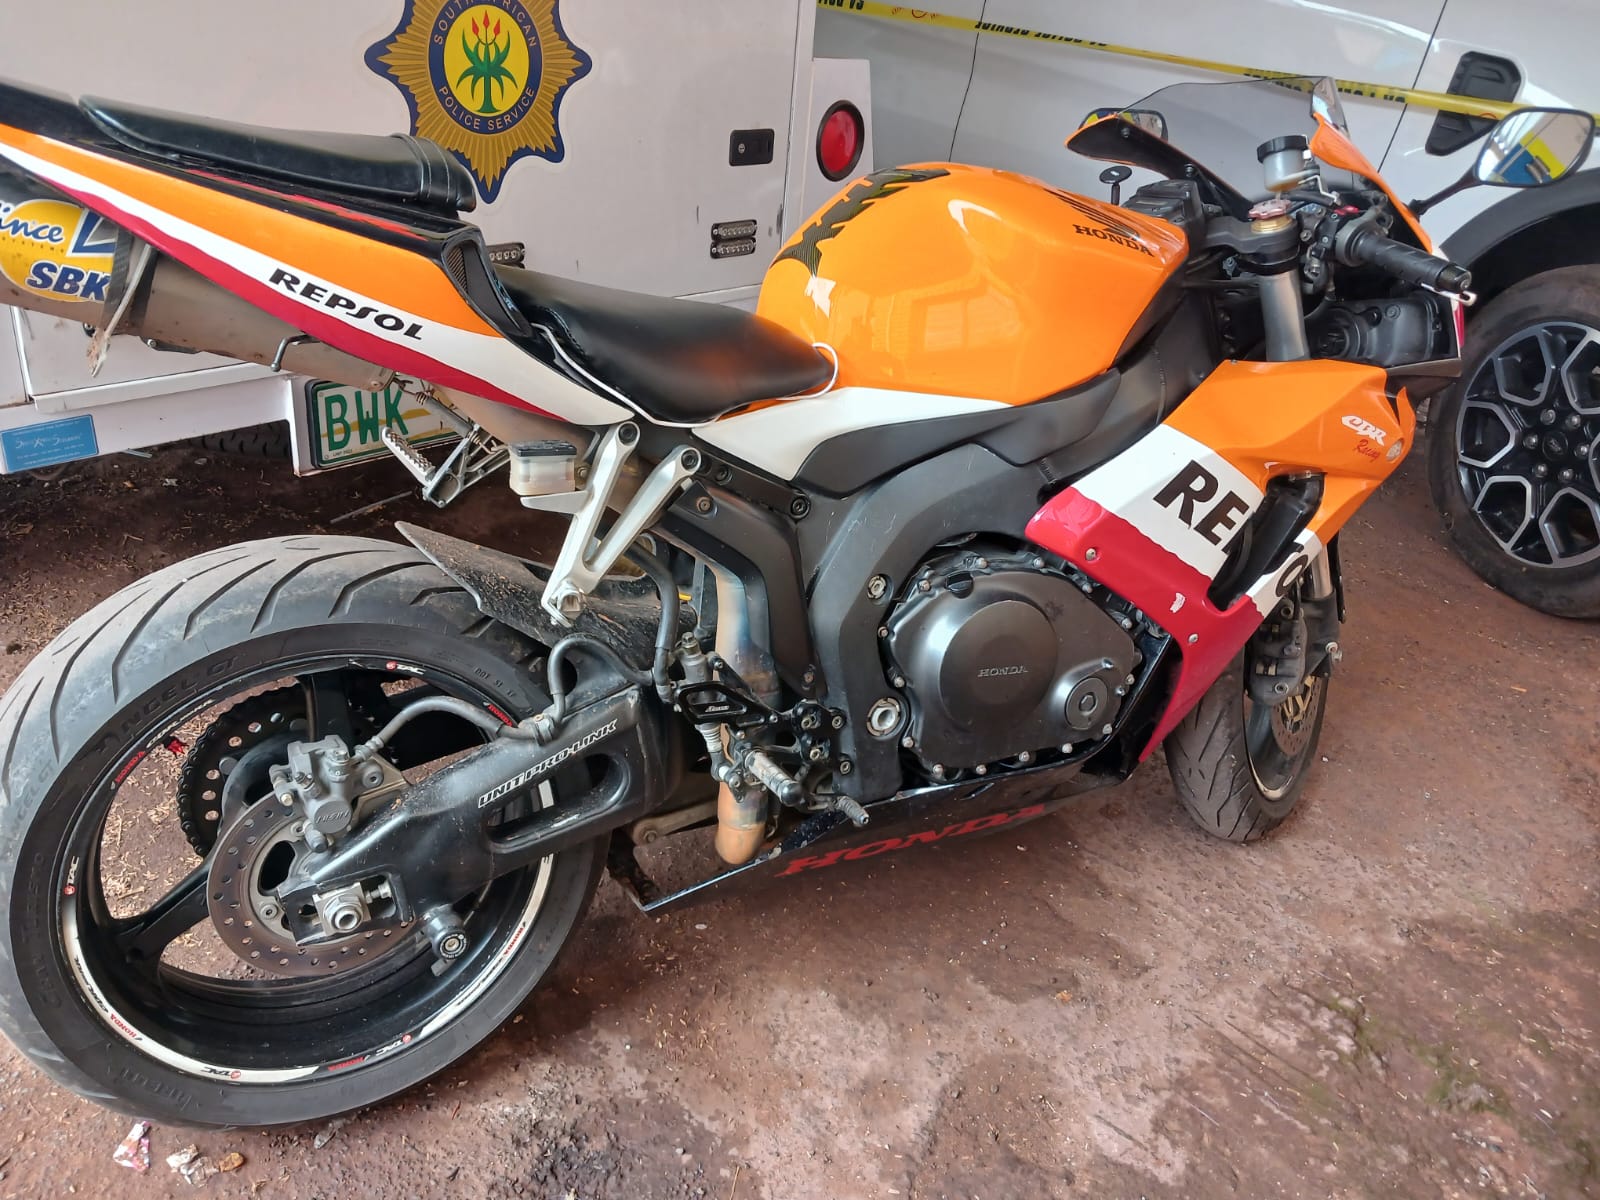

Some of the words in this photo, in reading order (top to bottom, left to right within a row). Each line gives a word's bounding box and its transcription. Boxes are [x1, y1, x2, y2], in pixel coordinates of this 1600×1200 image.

[438, 86, 481, 130] POLICE
[487, 87, 535, 131] SERVICE
[1072, 224, 1155, 257] HONDA
[26, 261, 111, 301] SBK
[268, 268, 423, 340] REPSOL
[324, 384, 409, 452] BWK
[977, 665, 1029, 678] HONDA
[478, 772, 526, 809] UNIT
[524, 718, 618, 782] PRO-LINK
[774, 803, 1046, 879] HONDA
[111, 1013, 137, 1039] HONDA
